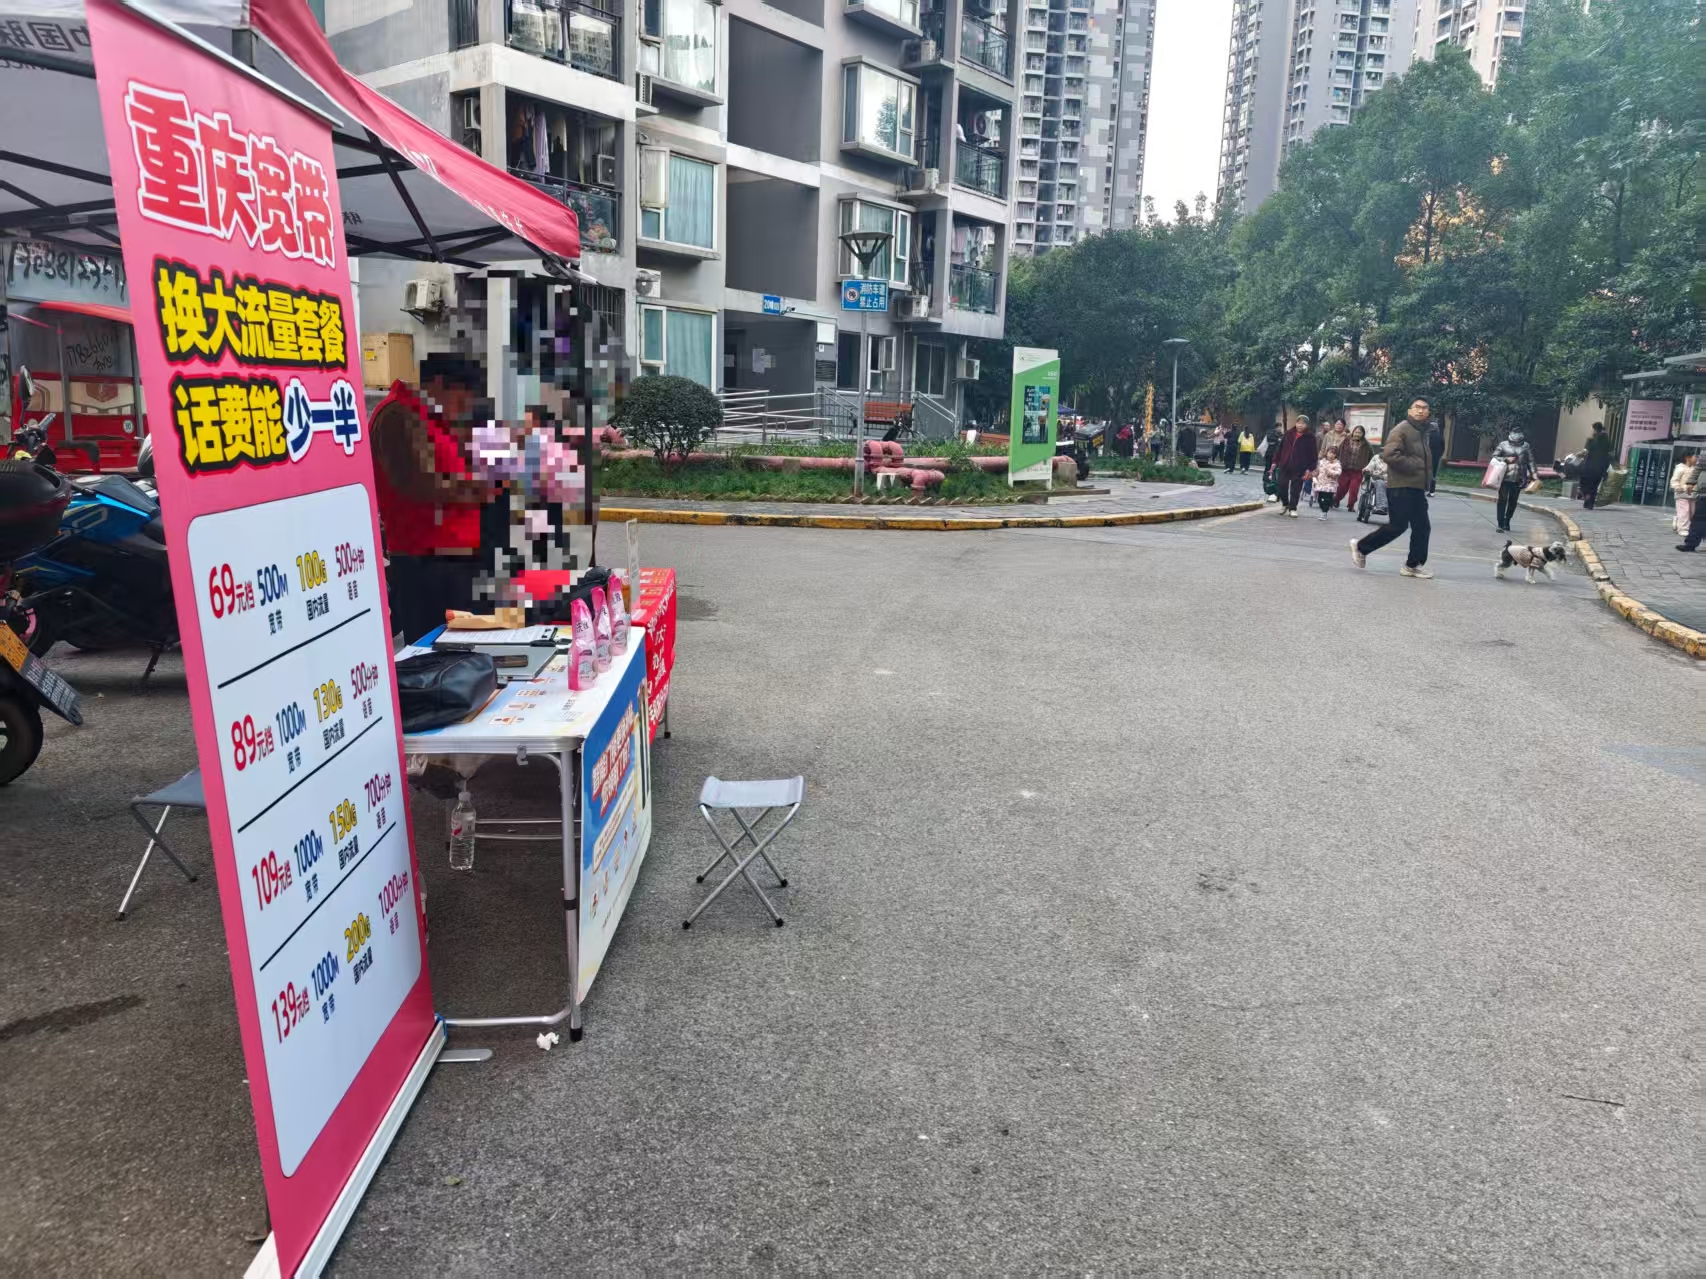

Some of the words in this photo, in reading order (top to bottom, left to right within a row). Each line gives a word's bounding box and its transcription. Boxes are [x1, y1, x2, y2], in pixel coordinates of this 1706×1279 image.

[125, 82, 336, 267] 重庆宽带
[158, 265, 347, 366] 换大流量套餐
[860, 296, 885, 308] 禁止占用
[177, 379, 362, 468] 话费能少一半
[208, 563, 255, 619] 69元档
[257, 564, 288, 607] 500M
[296, 550, 328, 592] 100G
[335, 542, 364, 578] 500分钟
[306, 593, 330, 621] 国内流量
[231, 714, 274, 772] 89元档
[275, 701, 307, 747] 1000M
[313, 678, 343, 723] 130G
[350, 661, 379, 699] 500分钟
[322, 718, 346, 750] 国内流量
[252, 850, 293, 911] 109元档
[293, 829, 324, 877] 1000M
[329, 798, 358, 845] 150G
[364, 772, 392, 813] 700分钟
[338, 834, 359, 871] 国内流量
[272, 981, 311, 1044] 139元档
[311, 950, 340, 1001] 1000M
[344, 912, 372, 964] 200G
[378, 870, 408, 920] 1000分钟
[352, 945, 374, 985] 国内流量
